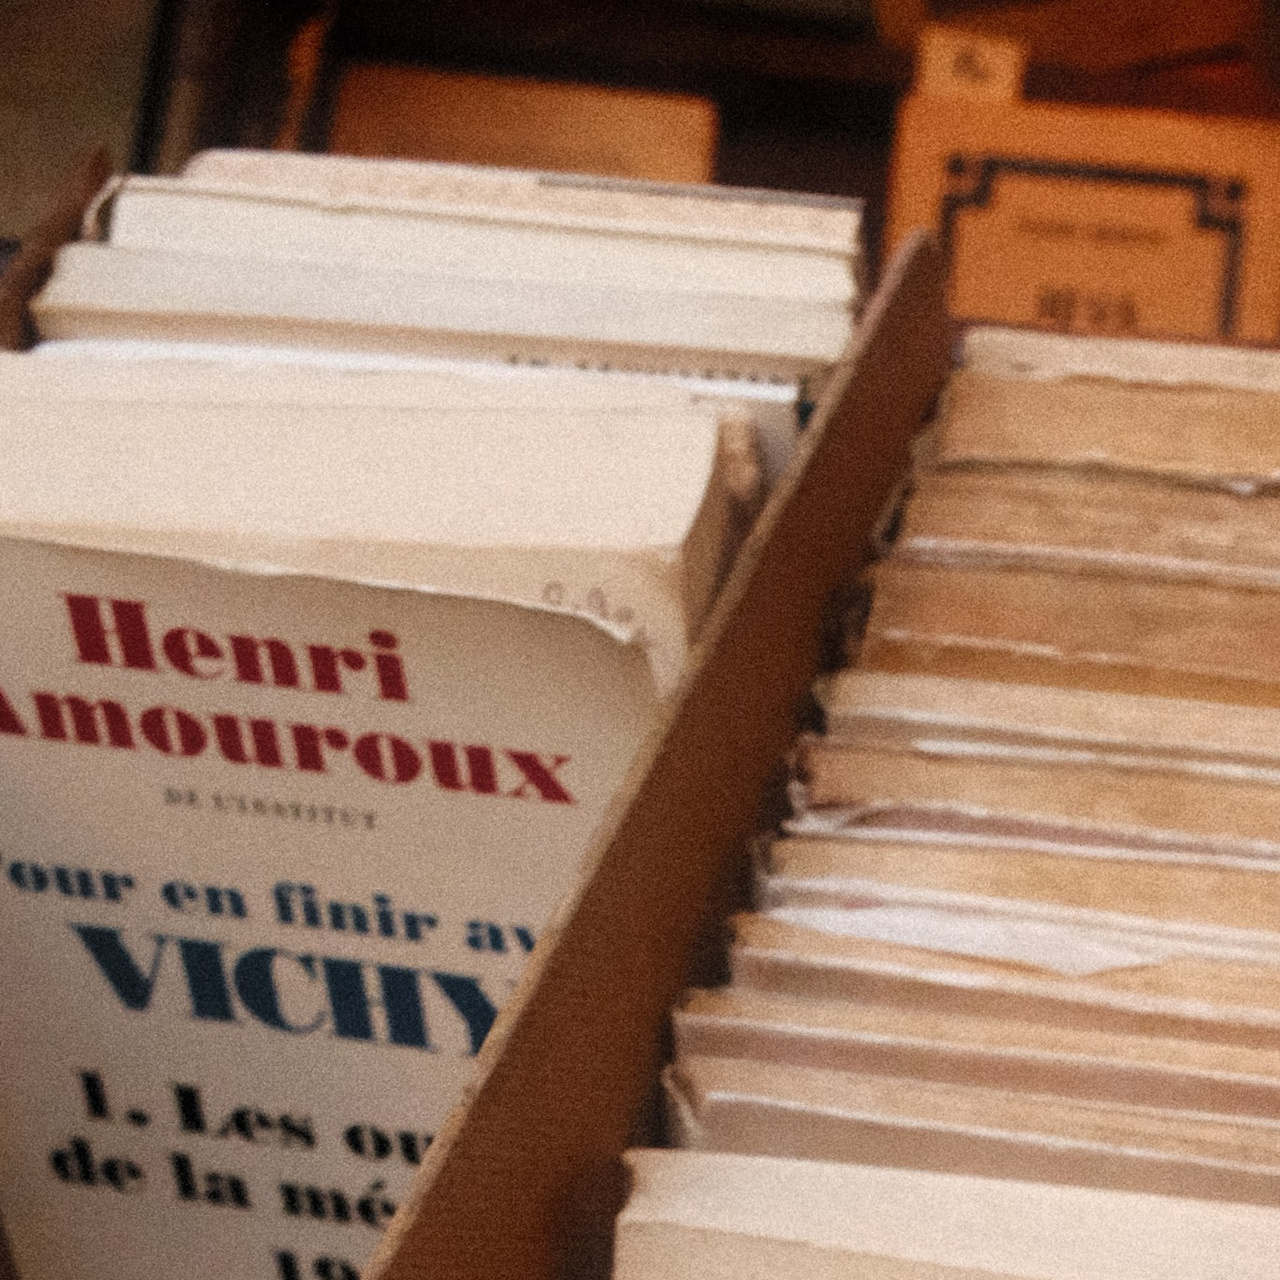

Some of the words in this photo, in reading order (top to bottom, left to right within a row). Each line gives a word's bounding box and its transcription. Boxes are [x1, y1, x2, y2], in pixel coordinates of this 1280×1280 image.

[63, 593, 410, 703] Henri
[0, 855, 135, 904] our
[161, 880, 248, 921] en
[273, 880, 438, 942] finir
[68, 920, 499, 1058] VICHY
[171, 1080, 317, 1149] Les
[50, 1135, 145, 1194] de
[170, 1150, 251, 1210] la
